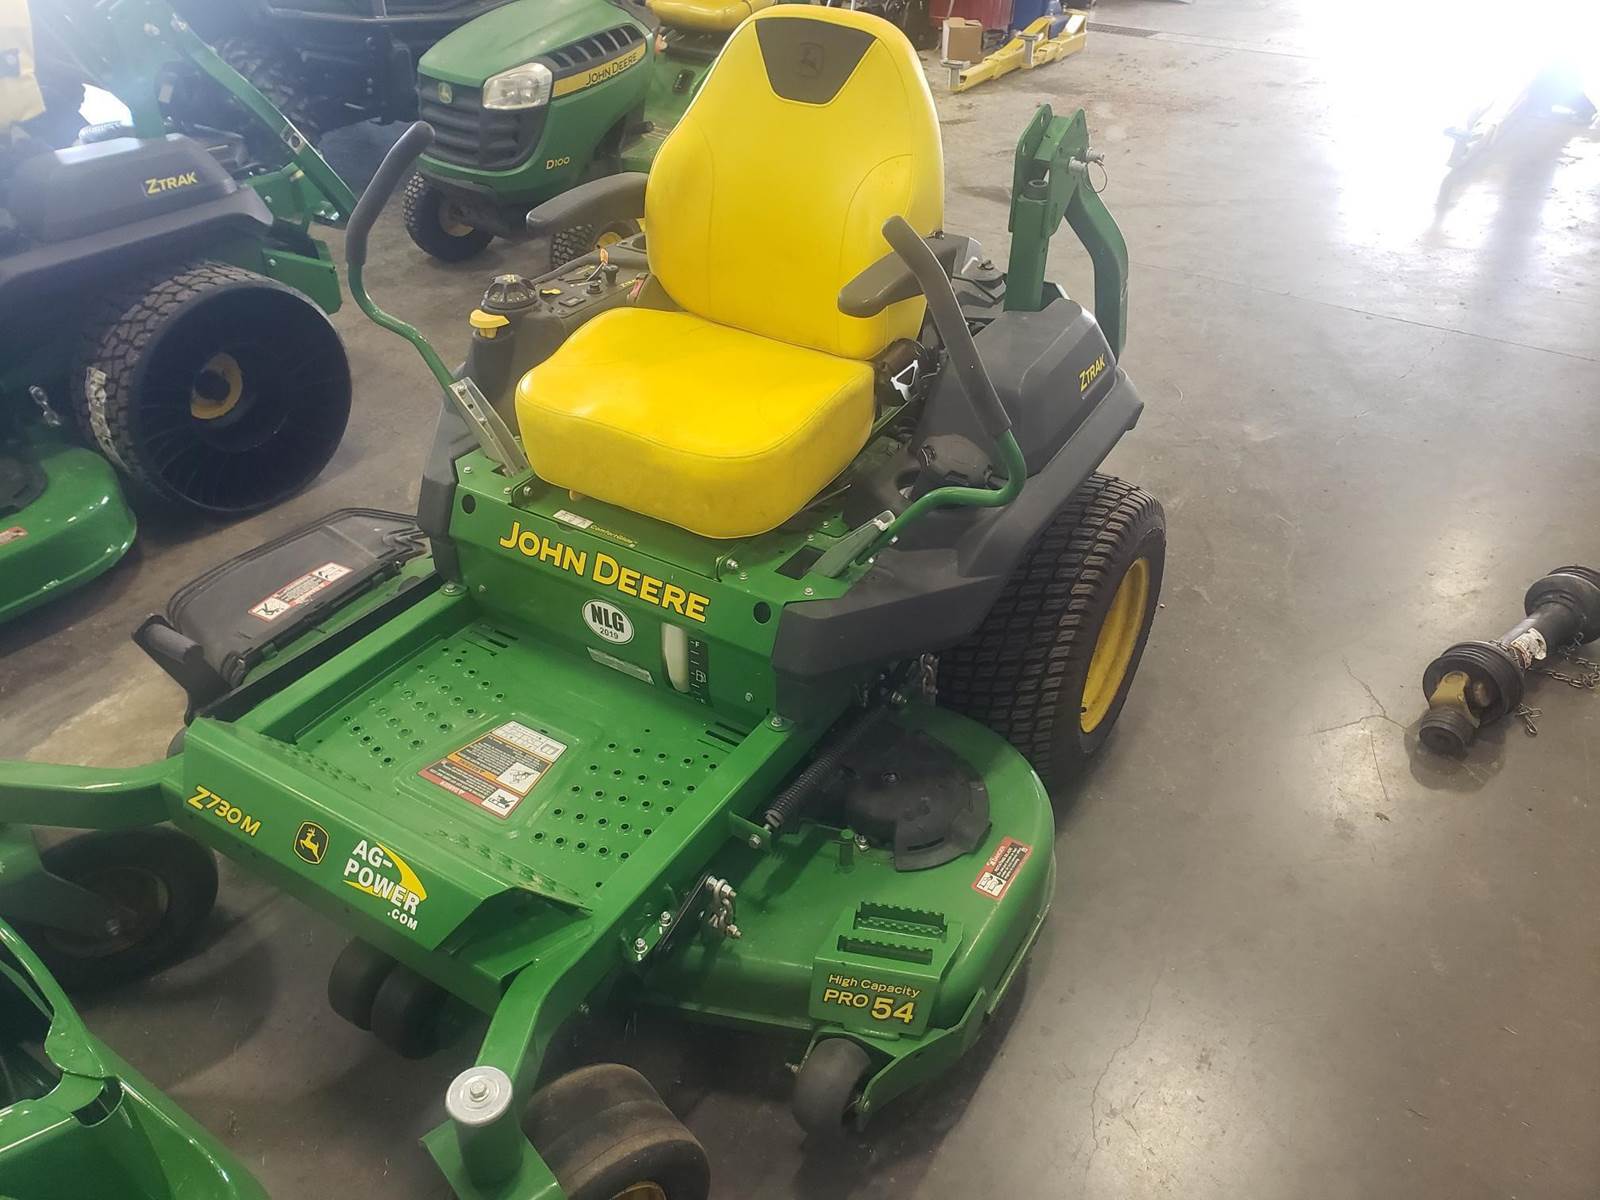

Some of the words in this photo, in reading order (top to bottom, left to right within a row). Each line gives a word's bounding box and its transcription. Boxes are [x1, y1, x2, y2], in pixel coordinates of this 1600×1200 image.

[586, 68, 611, 86] JOHN
[612, 53, 638, 74] DEERE
[546, 156, 570, 170] D100
[144, 171, 198, 194] ZTRAK
[1079, 353, 1106, 392] ZTRAK
[499, 521, 588, 577] JOHN
[592, 551, 711, 623] DEERE
[590, 604, 625, 633] NLG
[599, 627, 619, 640] 2019
[185, 785, 262, 838] Z730M
[351, 839, 393, 870] AG-
[343, 857, 422, 917] POWER
[386, 909, 419, 931] .COM
[828, 974, 858, 988] High
[861, 980, 921, 998] Capacity
[823, 989, 869, 1009] PRO
[871, 999, 915, 1024] 54
